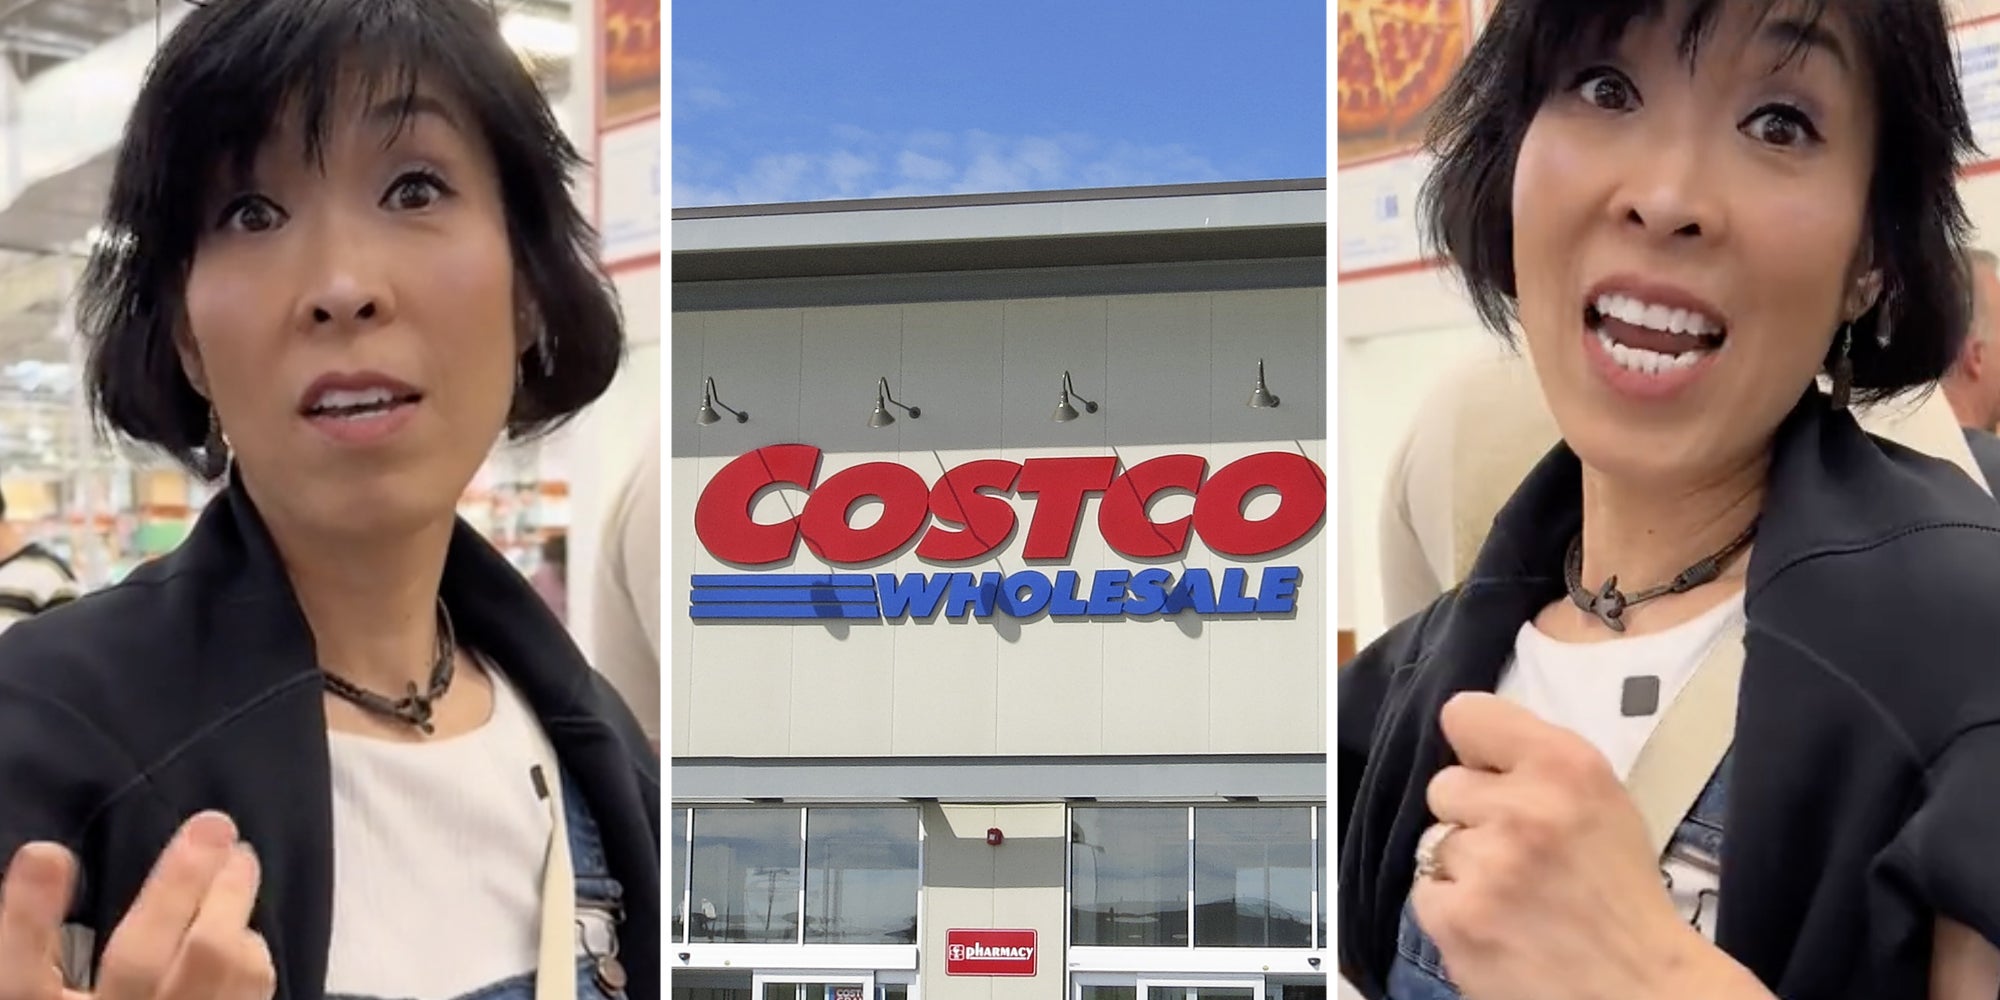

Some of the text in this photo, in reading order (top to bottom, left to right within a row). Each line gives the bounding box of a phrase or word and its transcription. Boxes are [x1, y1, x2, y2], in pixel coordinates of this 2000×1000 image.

[694, 443, 1326, 565] COSTCO
[876, 566, 1301, 619] WHOLESALE
[836, 988, 863, 998] COST
